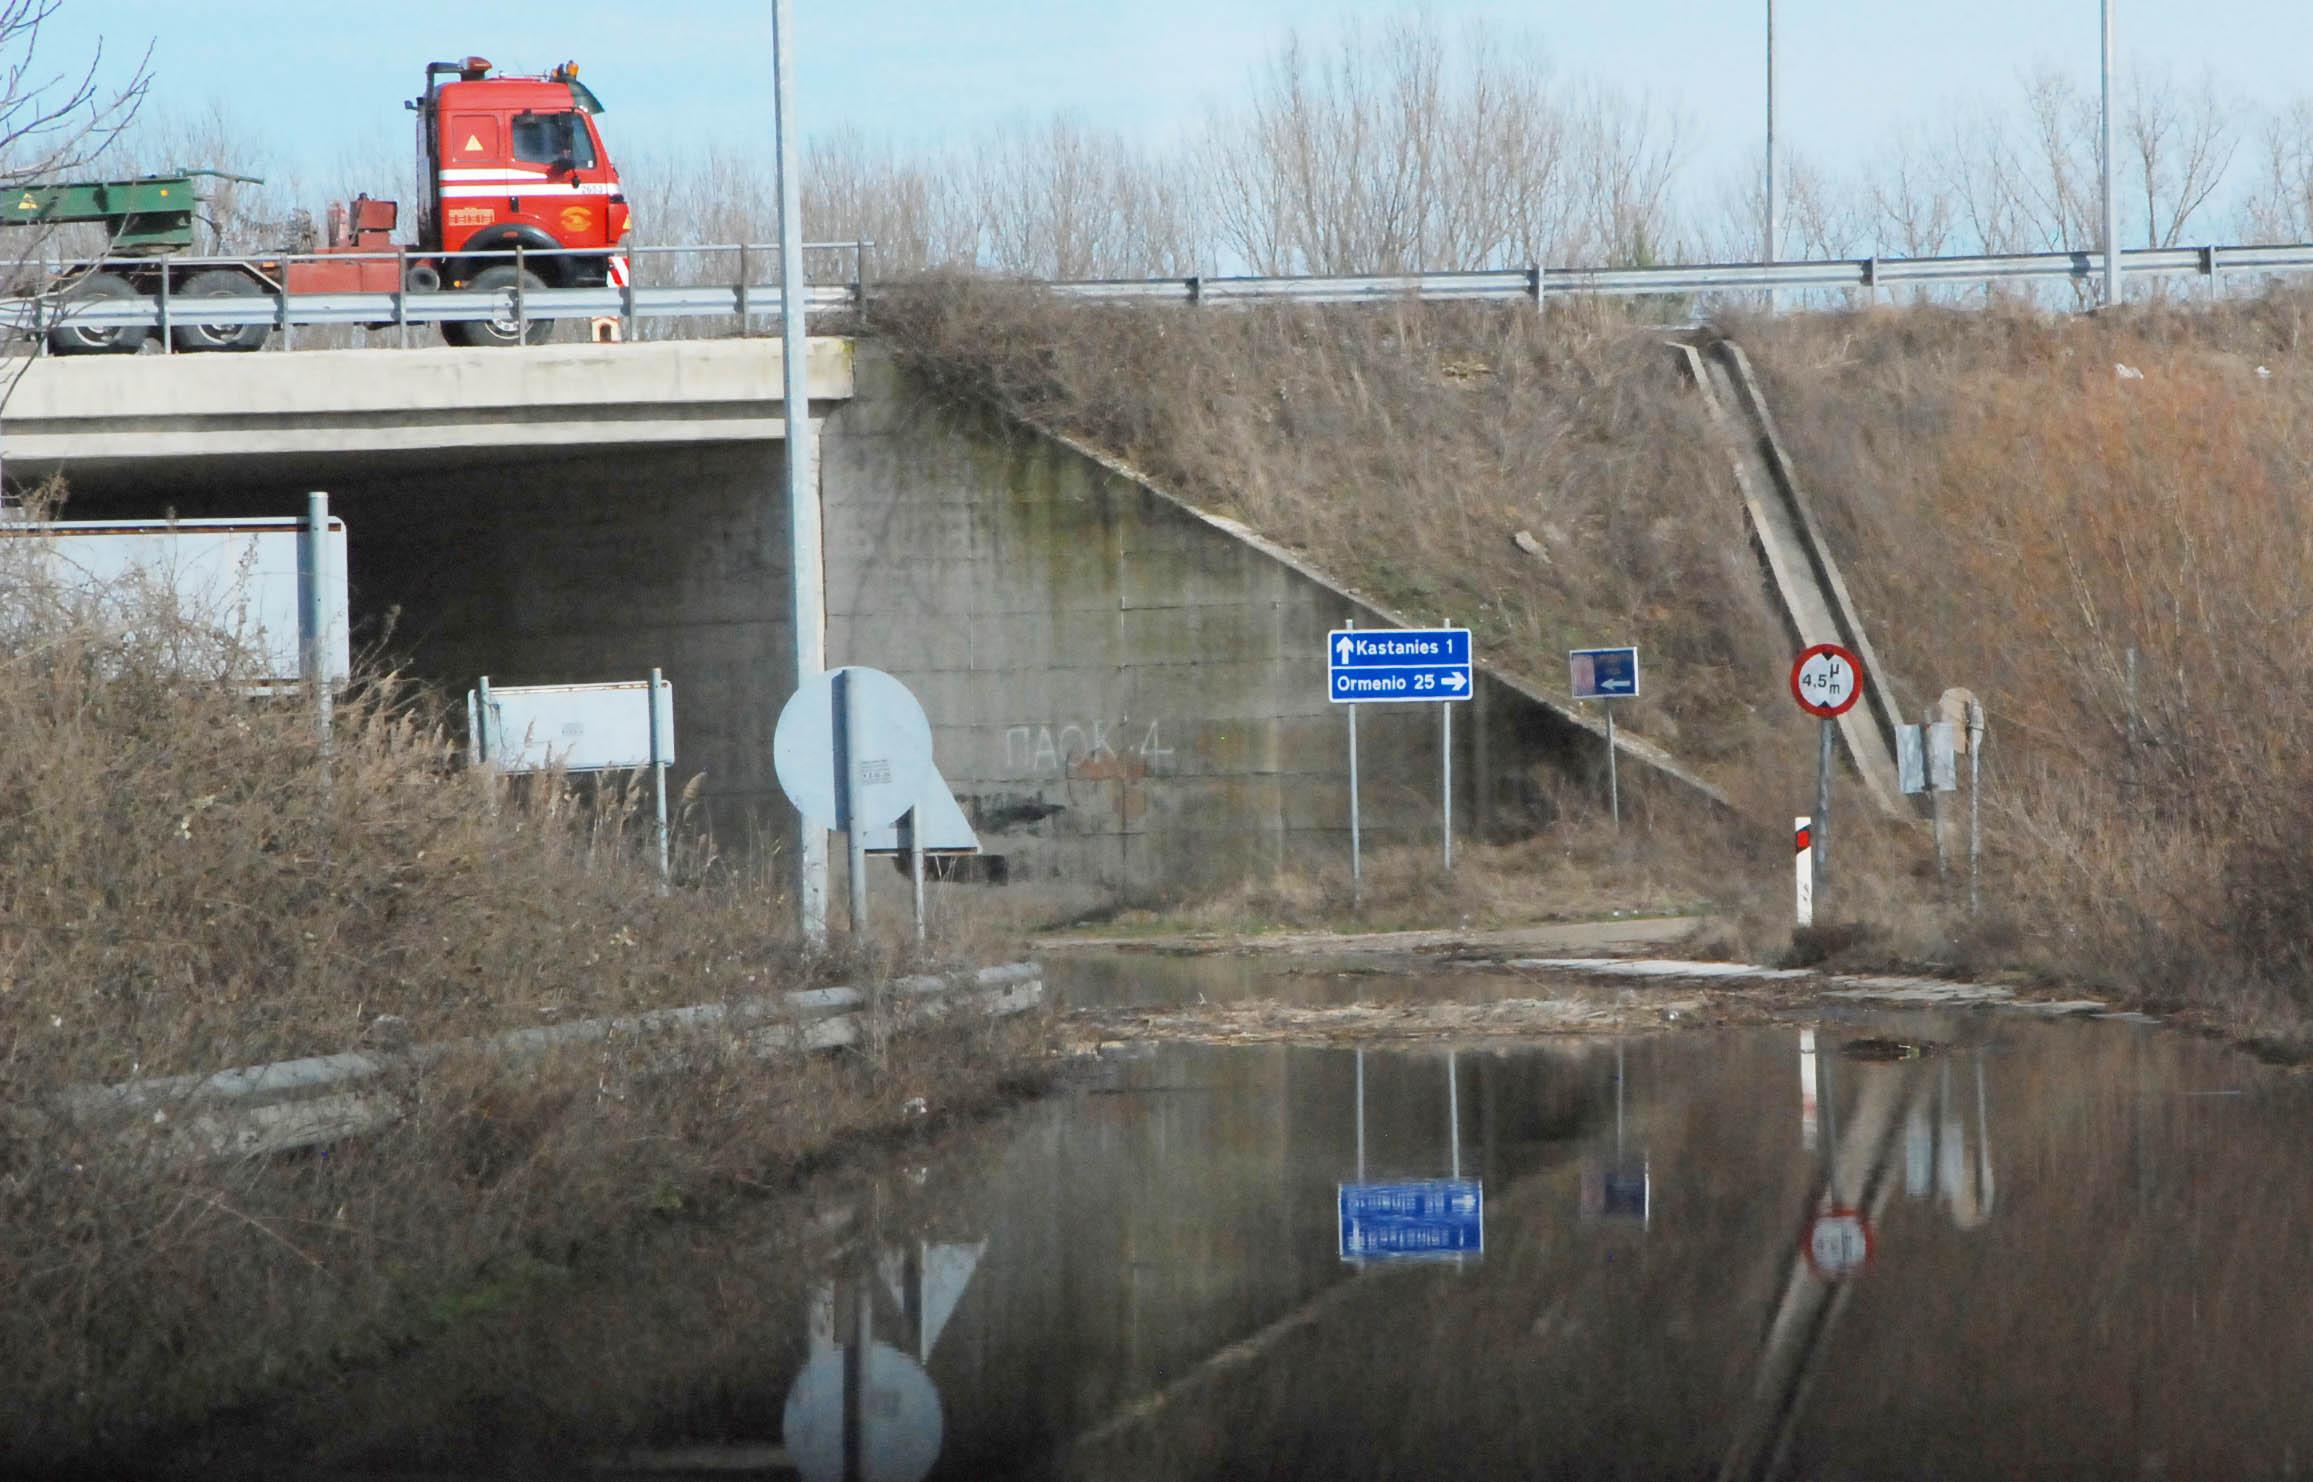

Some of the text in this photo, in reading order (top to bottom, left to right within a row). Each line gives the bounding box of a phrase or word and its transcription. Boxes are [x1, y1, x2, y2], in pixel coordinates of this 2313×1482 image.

[1356, 638, 1454, 656] Kastanies 1
[1337, 674, 1436, 691] Ormenio 25
[1801, 673, 1827, 689] 4.5
